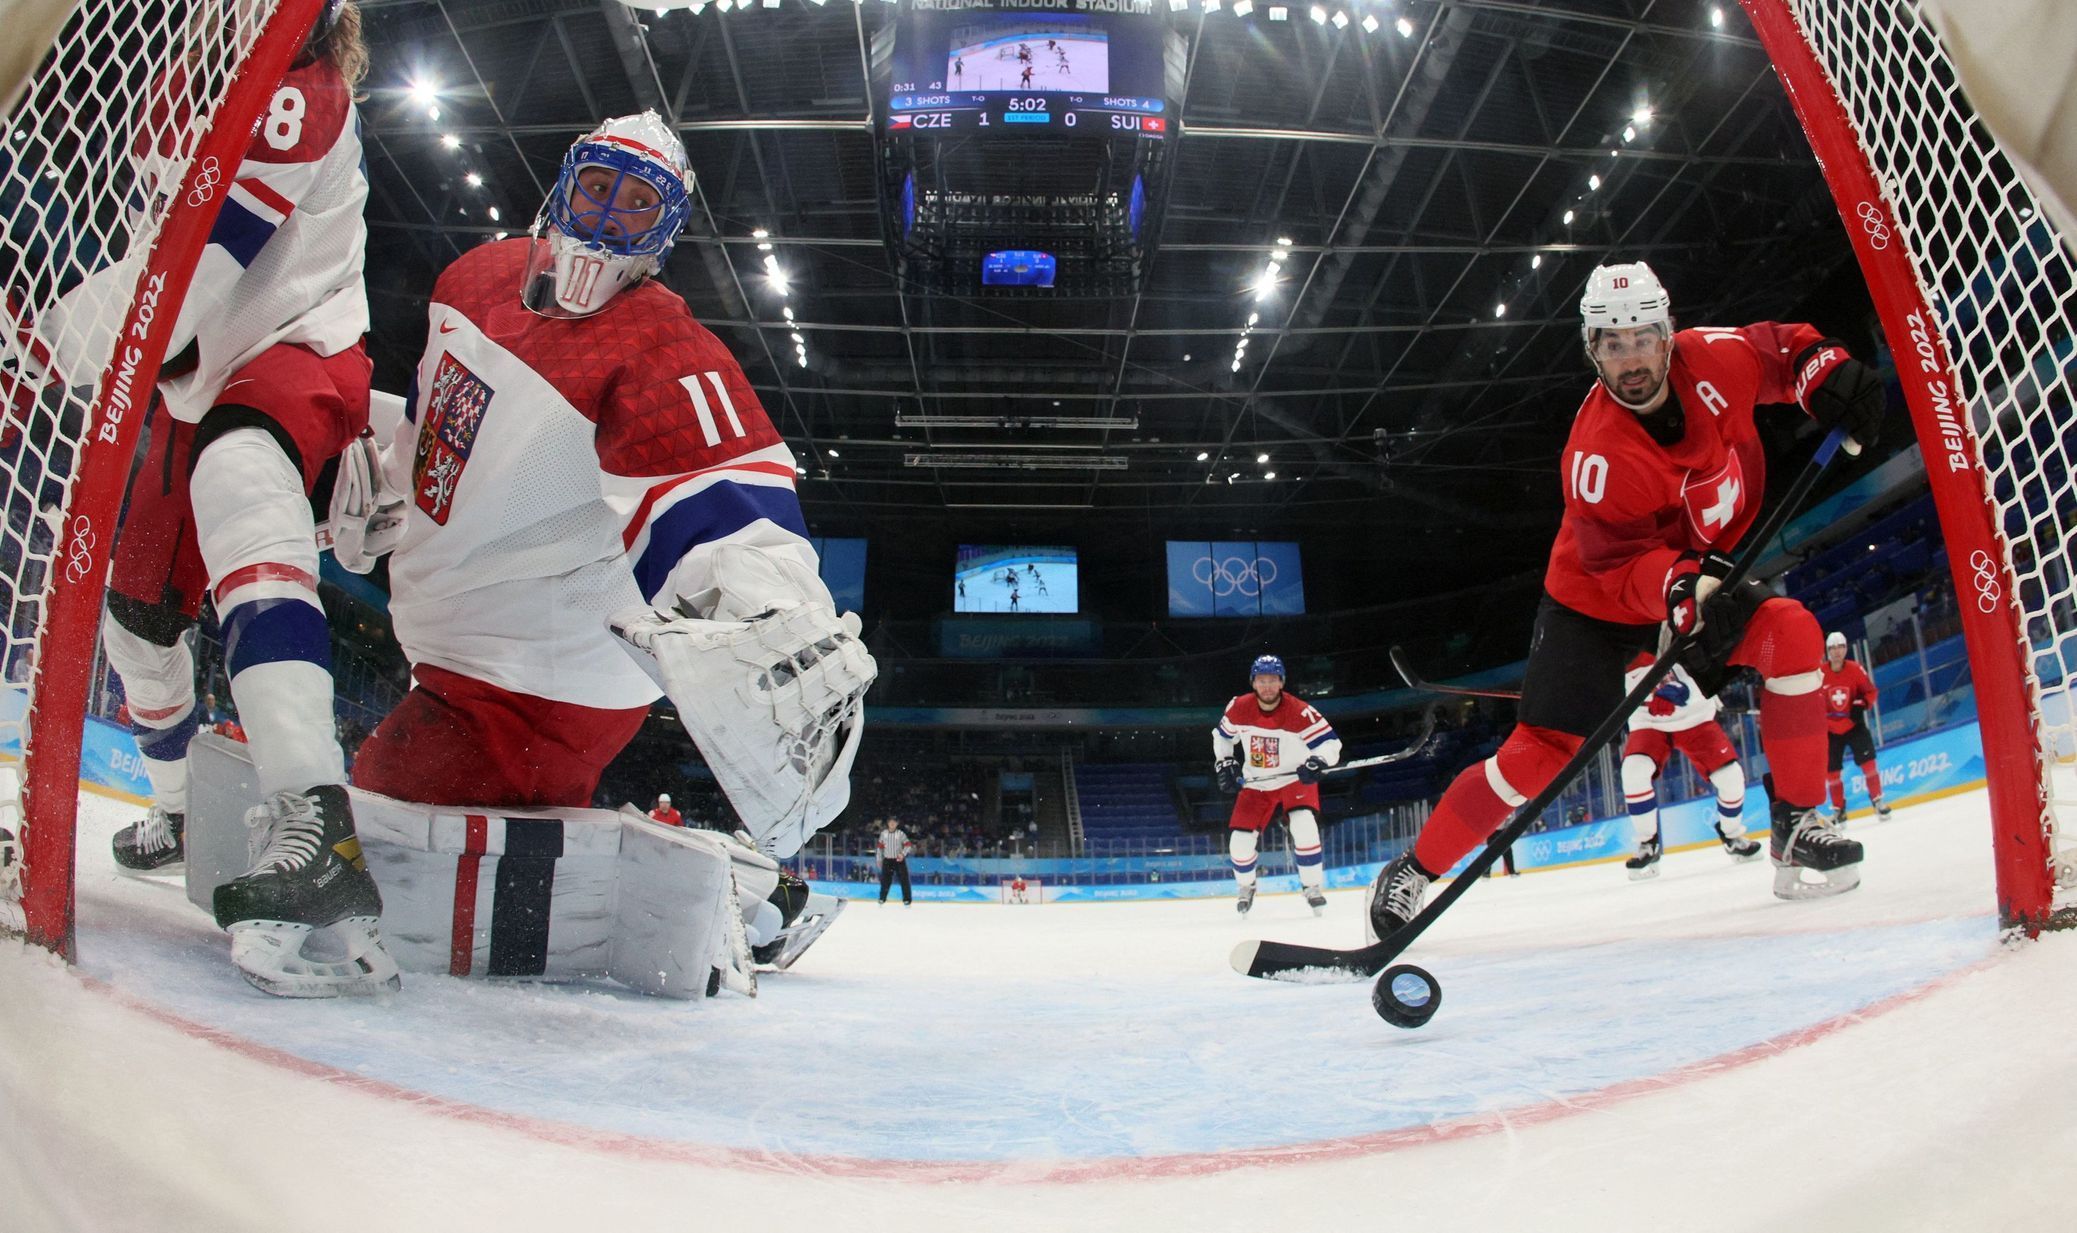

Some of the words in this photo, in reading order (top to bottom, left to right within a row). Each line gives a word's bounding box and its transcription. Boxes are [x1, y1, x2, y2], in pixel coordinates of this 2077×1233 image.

[911, 0, 993, 10] NATIONAL
[1000, 0, 1069, 9] INDOOR
[1075, 0, 1152, 15] STADIUM
[894, 83, 915, 92] 0:31
[928, 82, 942, 90] 43
[905, 97, 912, 107] 3
[916, 95, 951, 105] SHOTS
[1008, 98, 1046, 111] 5:02
[1103, 97, 1137, 107] SHOTS
[1142, 101, 1150, 109] 4
[913, 113, 952, 129] CZE
[978, 112, 989, 126] 1
[1064, 112, 1077, 127] 0
[1111, 114, 1141, 130] SUI
[563, 255, 604, 308] 11
[1612, 277, 1629, 290] 10
[1906, 307, 1941, 374] 2022
[98, 345, 143, 444] BEIJING
[132, 271, 168, 340] 2022
[1695, 380, 1729, 416] A
[678, 371, 747, 447] 11
[1927, 380, 1970, 473] BEIJING
[1571, 451, 1609, 504] 10
[1907, 752, 1953, 780] 2022
